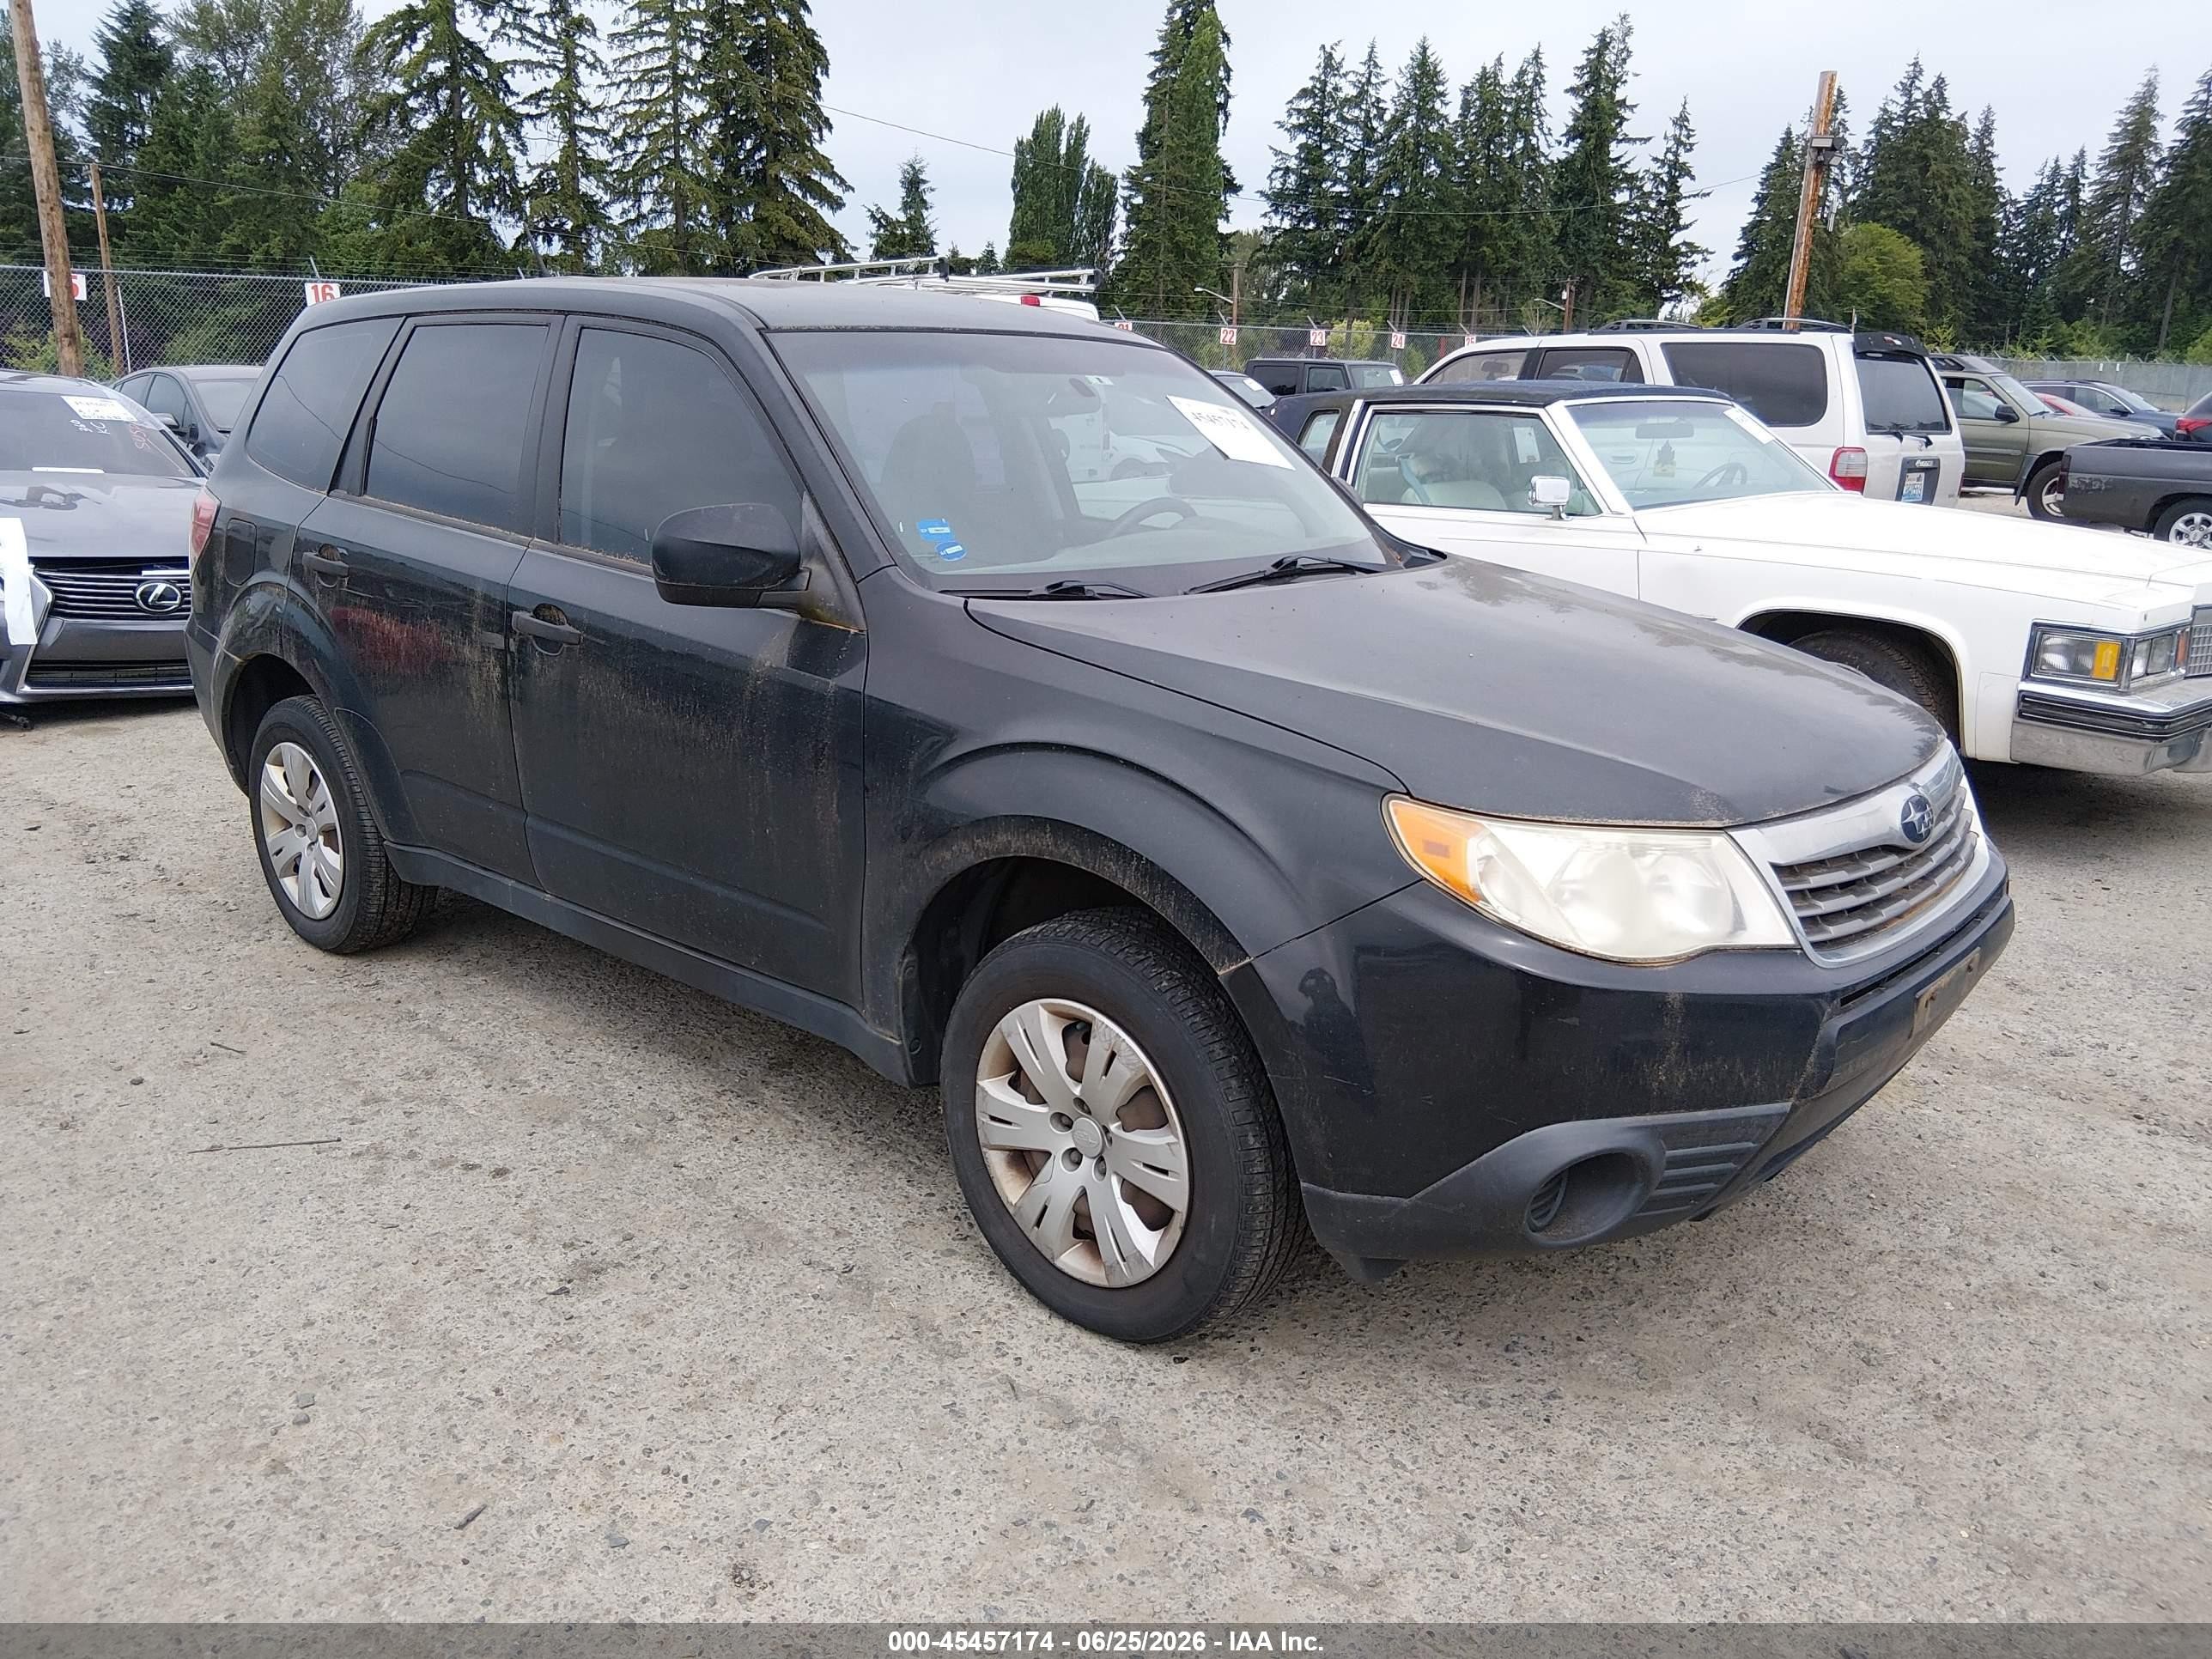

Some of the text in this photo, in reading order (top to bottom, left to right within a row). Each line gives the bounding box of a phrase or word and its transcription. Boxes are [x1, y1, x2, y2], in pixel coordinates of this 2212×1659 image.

[311, 284, 335, 302] 16
[1221, 330, 1235, 343] 22
[1311, 331, 1324, 345] 23
[1393, 334, 1404, 348] 24
